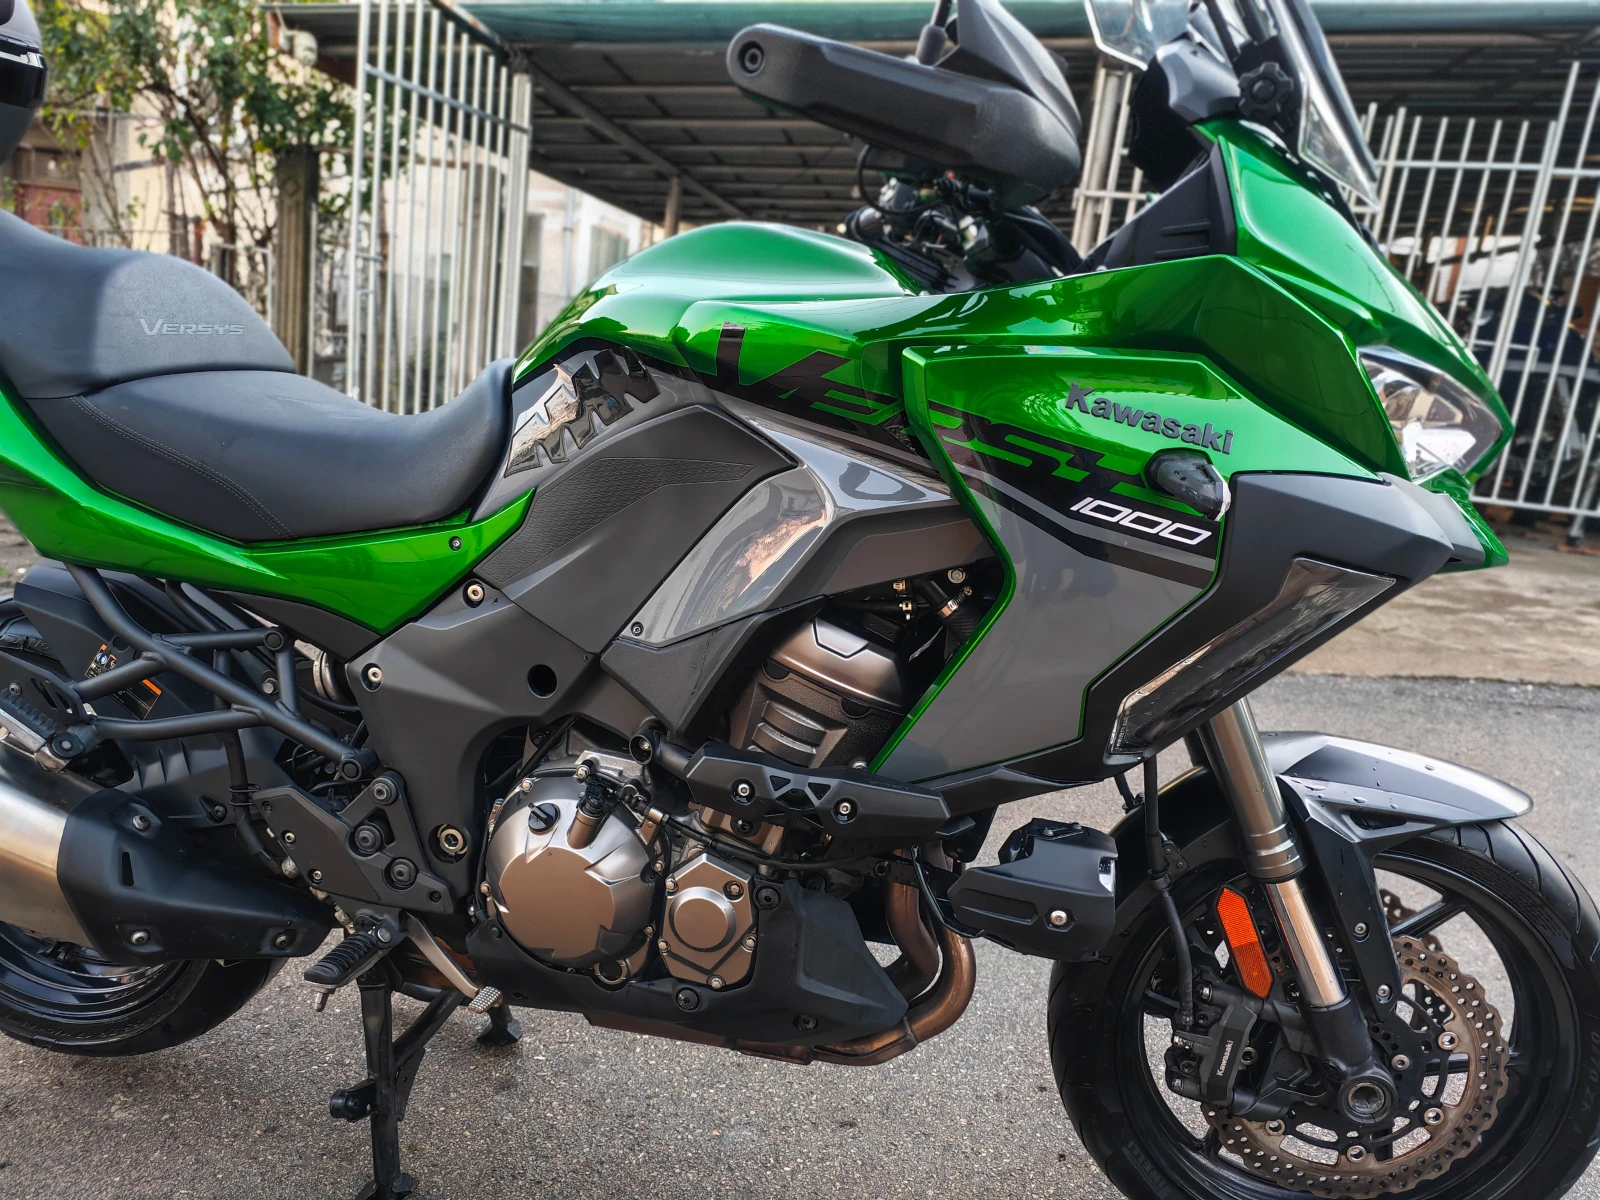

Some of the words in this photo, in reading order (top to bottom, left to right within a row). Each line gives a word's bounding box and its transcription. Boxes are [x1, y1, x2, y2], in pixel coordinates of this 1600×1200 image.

[139, 318, 246, 336] VERSYS
[1065, 383, 1235, 456] Kawasaki
[1069, 496, 1213, 546] 1000
[1216, 1040, 1235, 1078] Kawasaki
